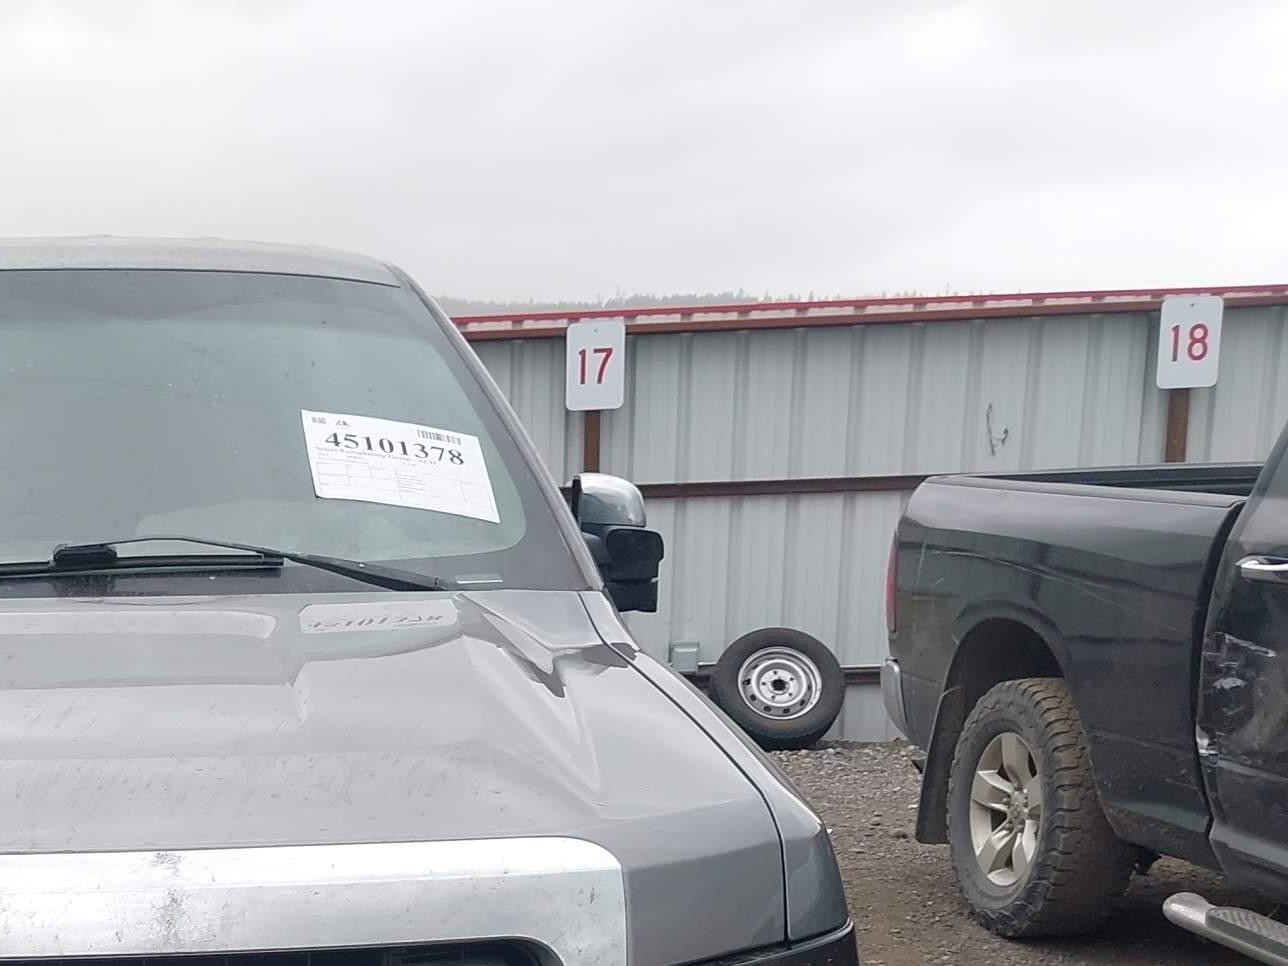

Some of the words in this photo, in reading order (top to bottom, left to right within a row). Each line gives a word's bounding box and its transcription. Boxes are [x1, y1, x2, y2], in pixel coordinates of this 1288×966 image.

[1171, 323, 1209, 362] 18
[578, 347, 614, 385] 17
[324, 431, 465, 466] 45101378
